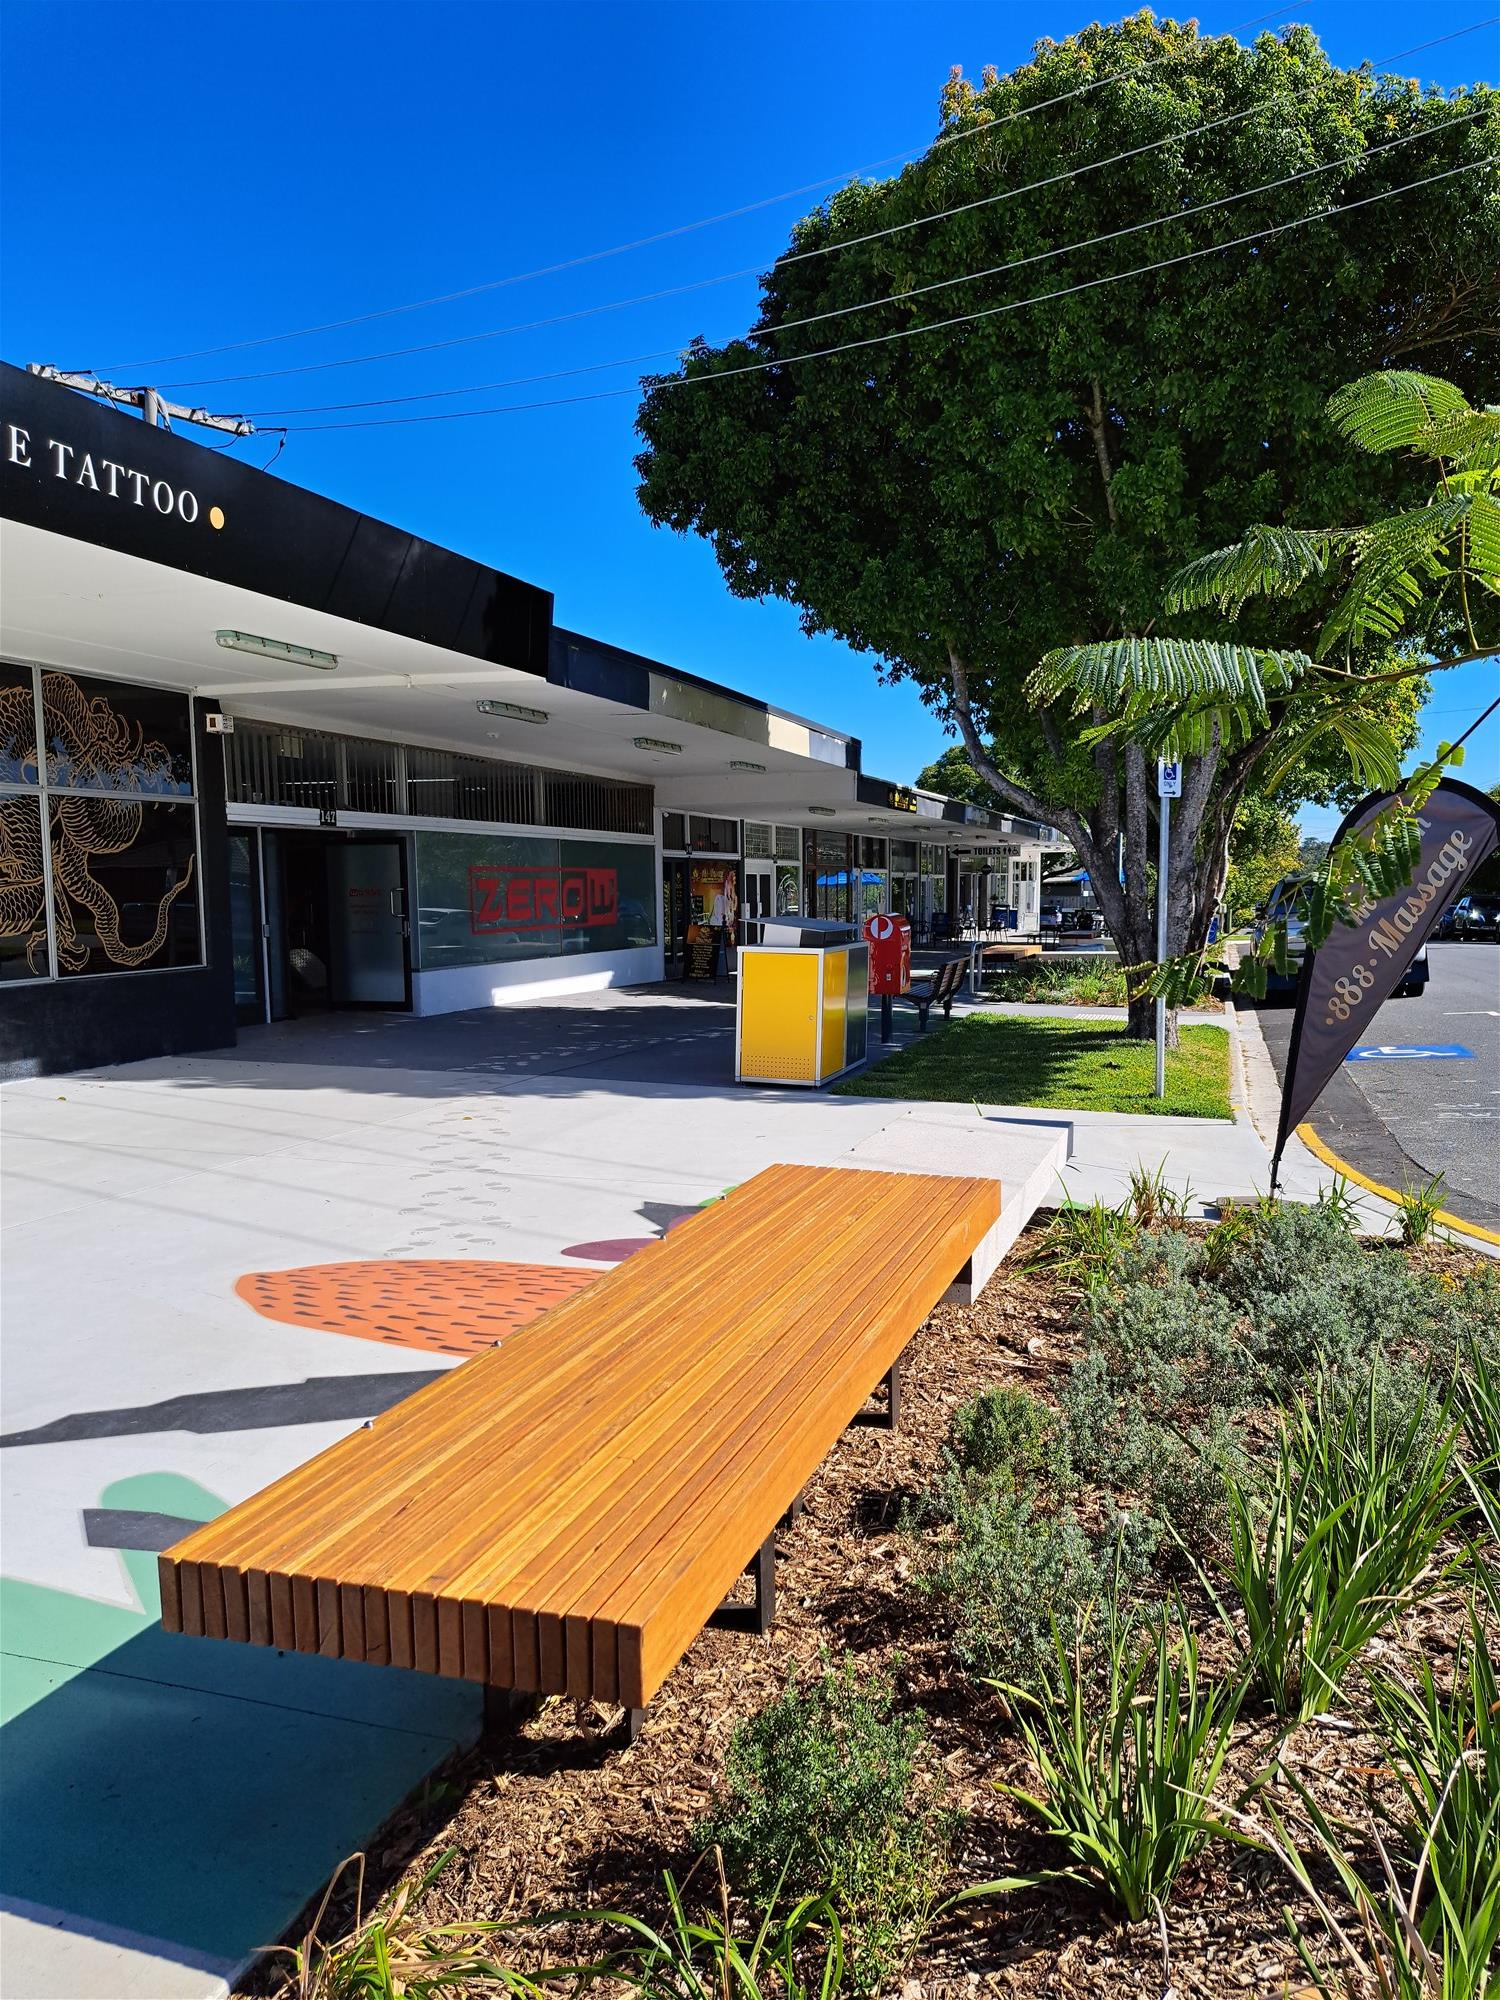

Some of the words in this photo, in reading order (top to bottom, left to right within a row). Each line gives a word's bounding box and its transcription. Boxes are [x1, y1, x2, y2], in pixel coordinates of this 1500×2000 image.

[48, 439, 199, 523] TATTOO
[320, 810, 336, 823] 147
[973, 847, 1001, 856] TOILETS
[1368, 829, 1473, 959] Massage
